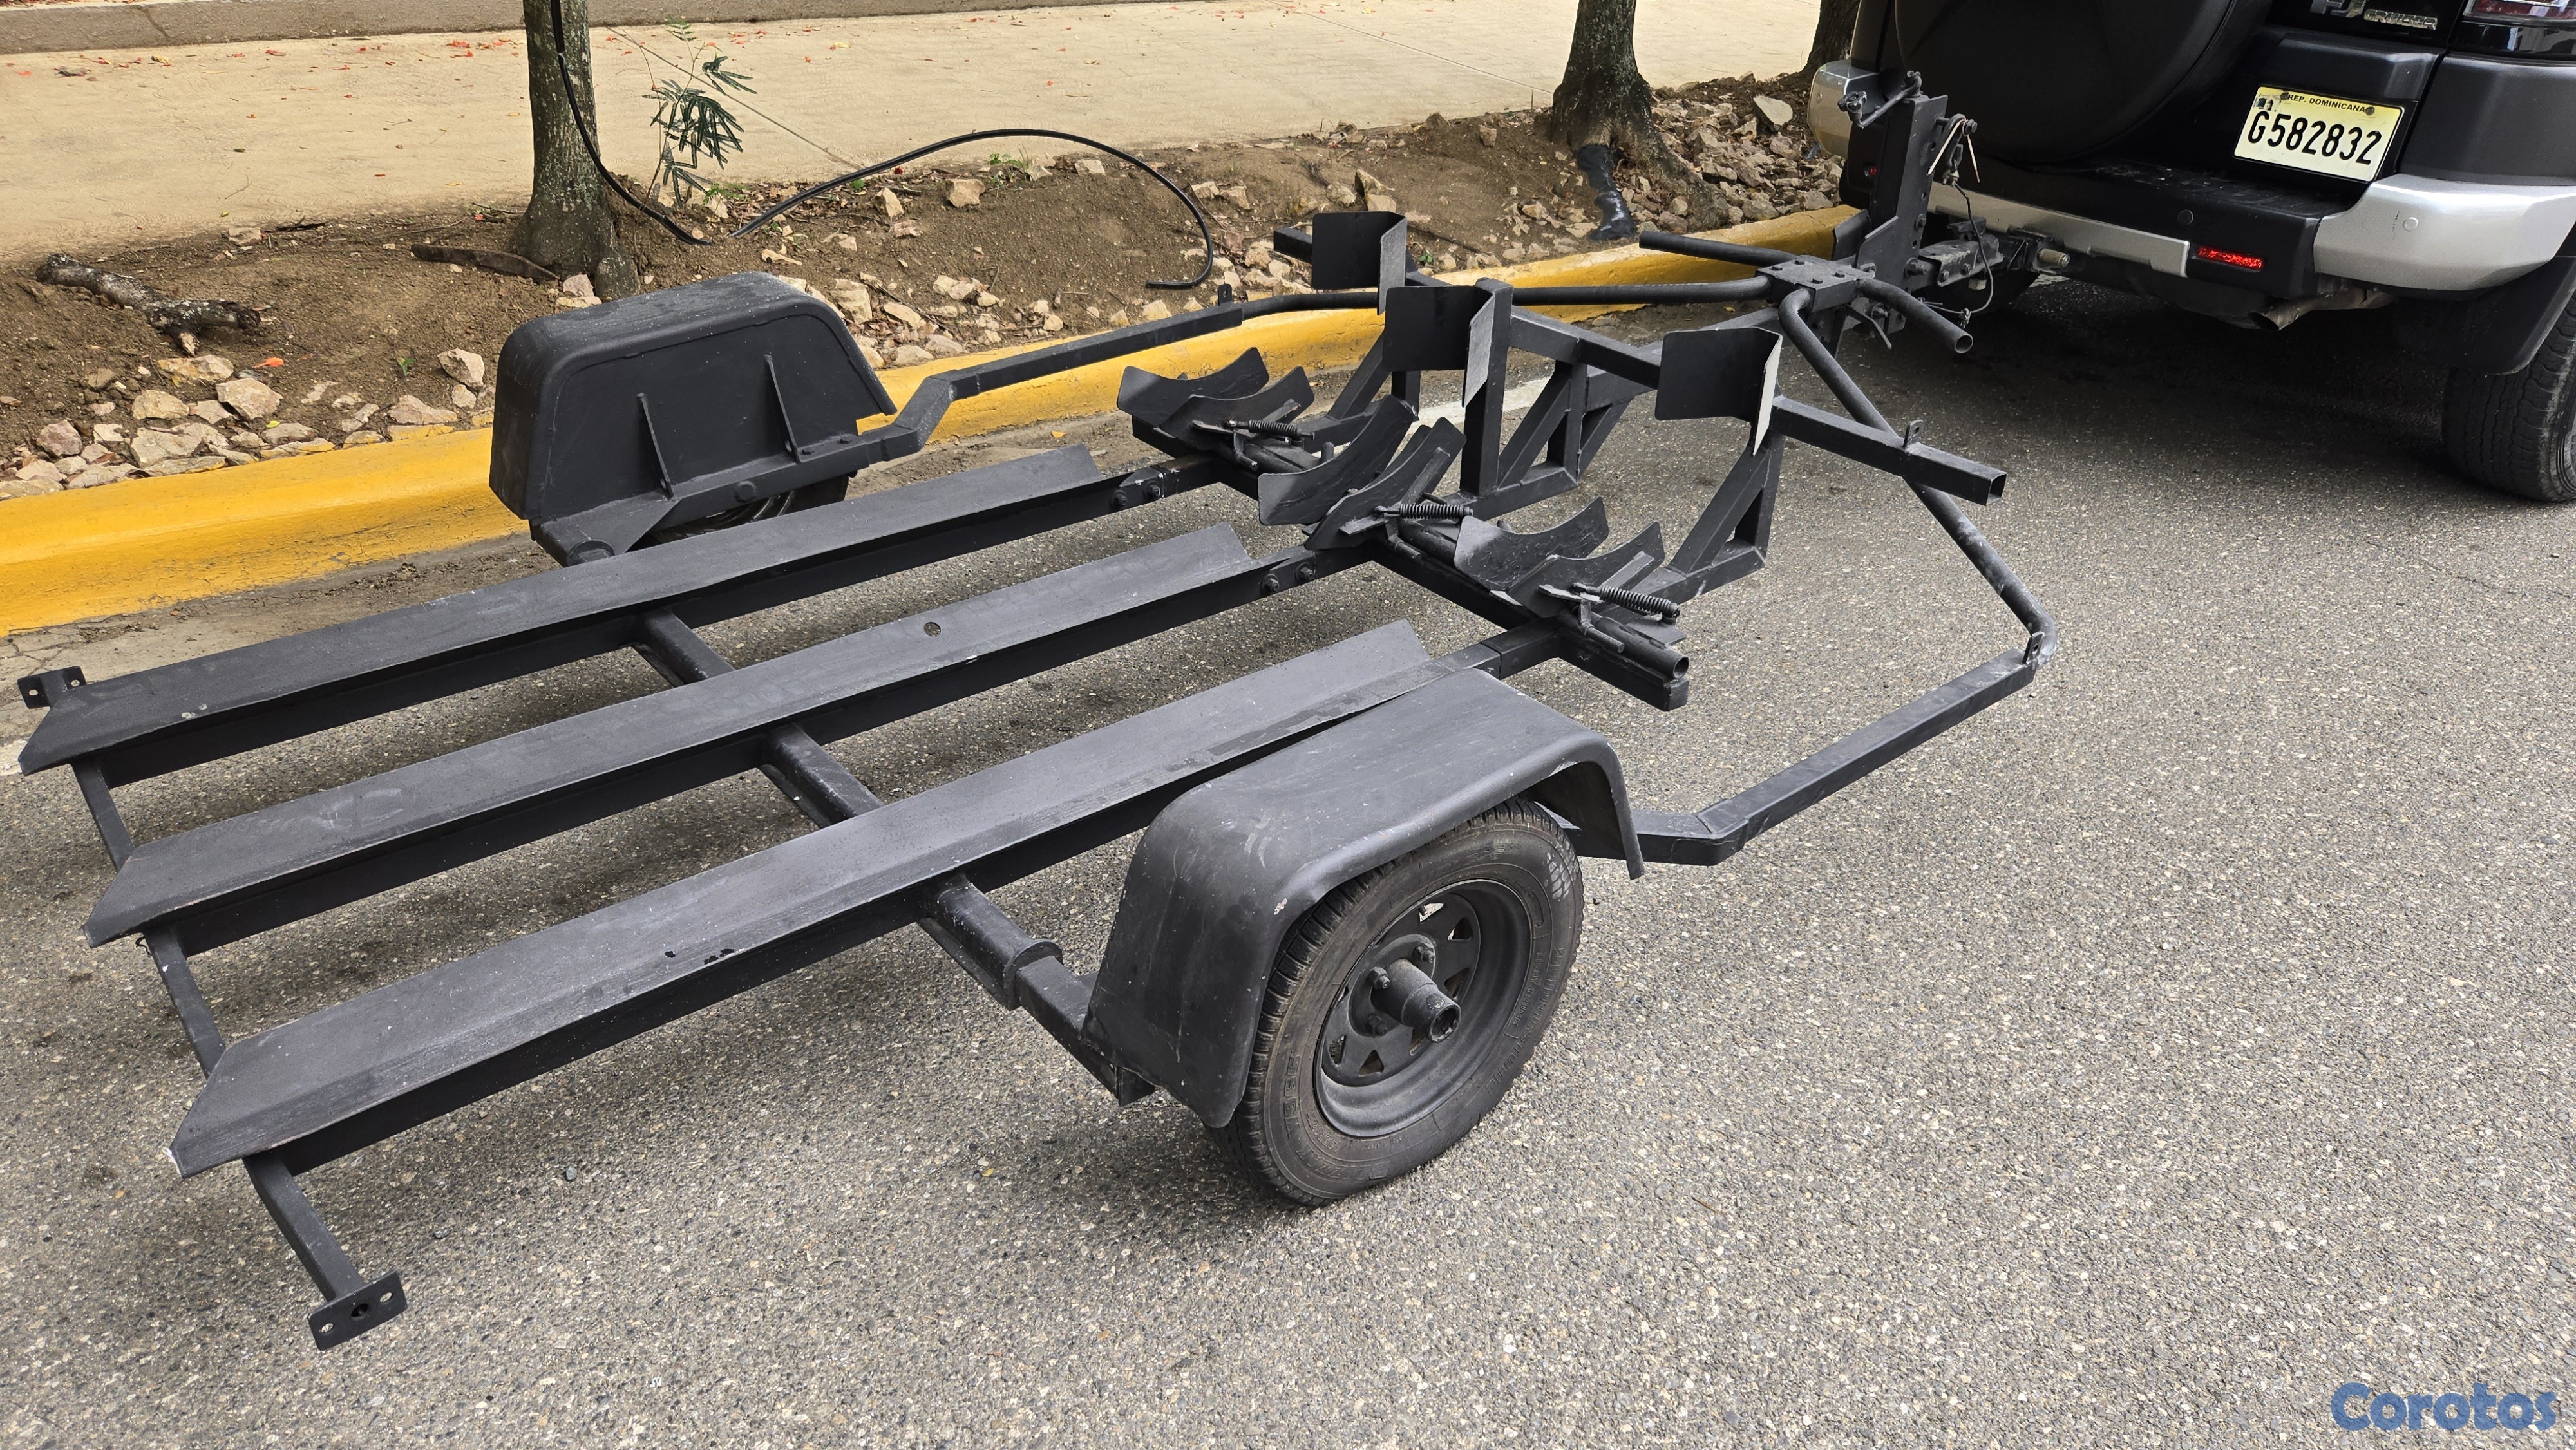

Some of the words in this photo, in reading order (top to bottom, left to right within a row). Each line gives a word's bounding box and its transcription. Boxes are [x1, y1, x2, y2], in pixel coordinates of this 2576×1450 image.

[2363, 8, 2438, 30] CRUISER
[2288, 93, 2307, 104] REP.
[2309, 97, 2366, 113] DOMINICANA
[2248, 111, 2382, 165] G582832
